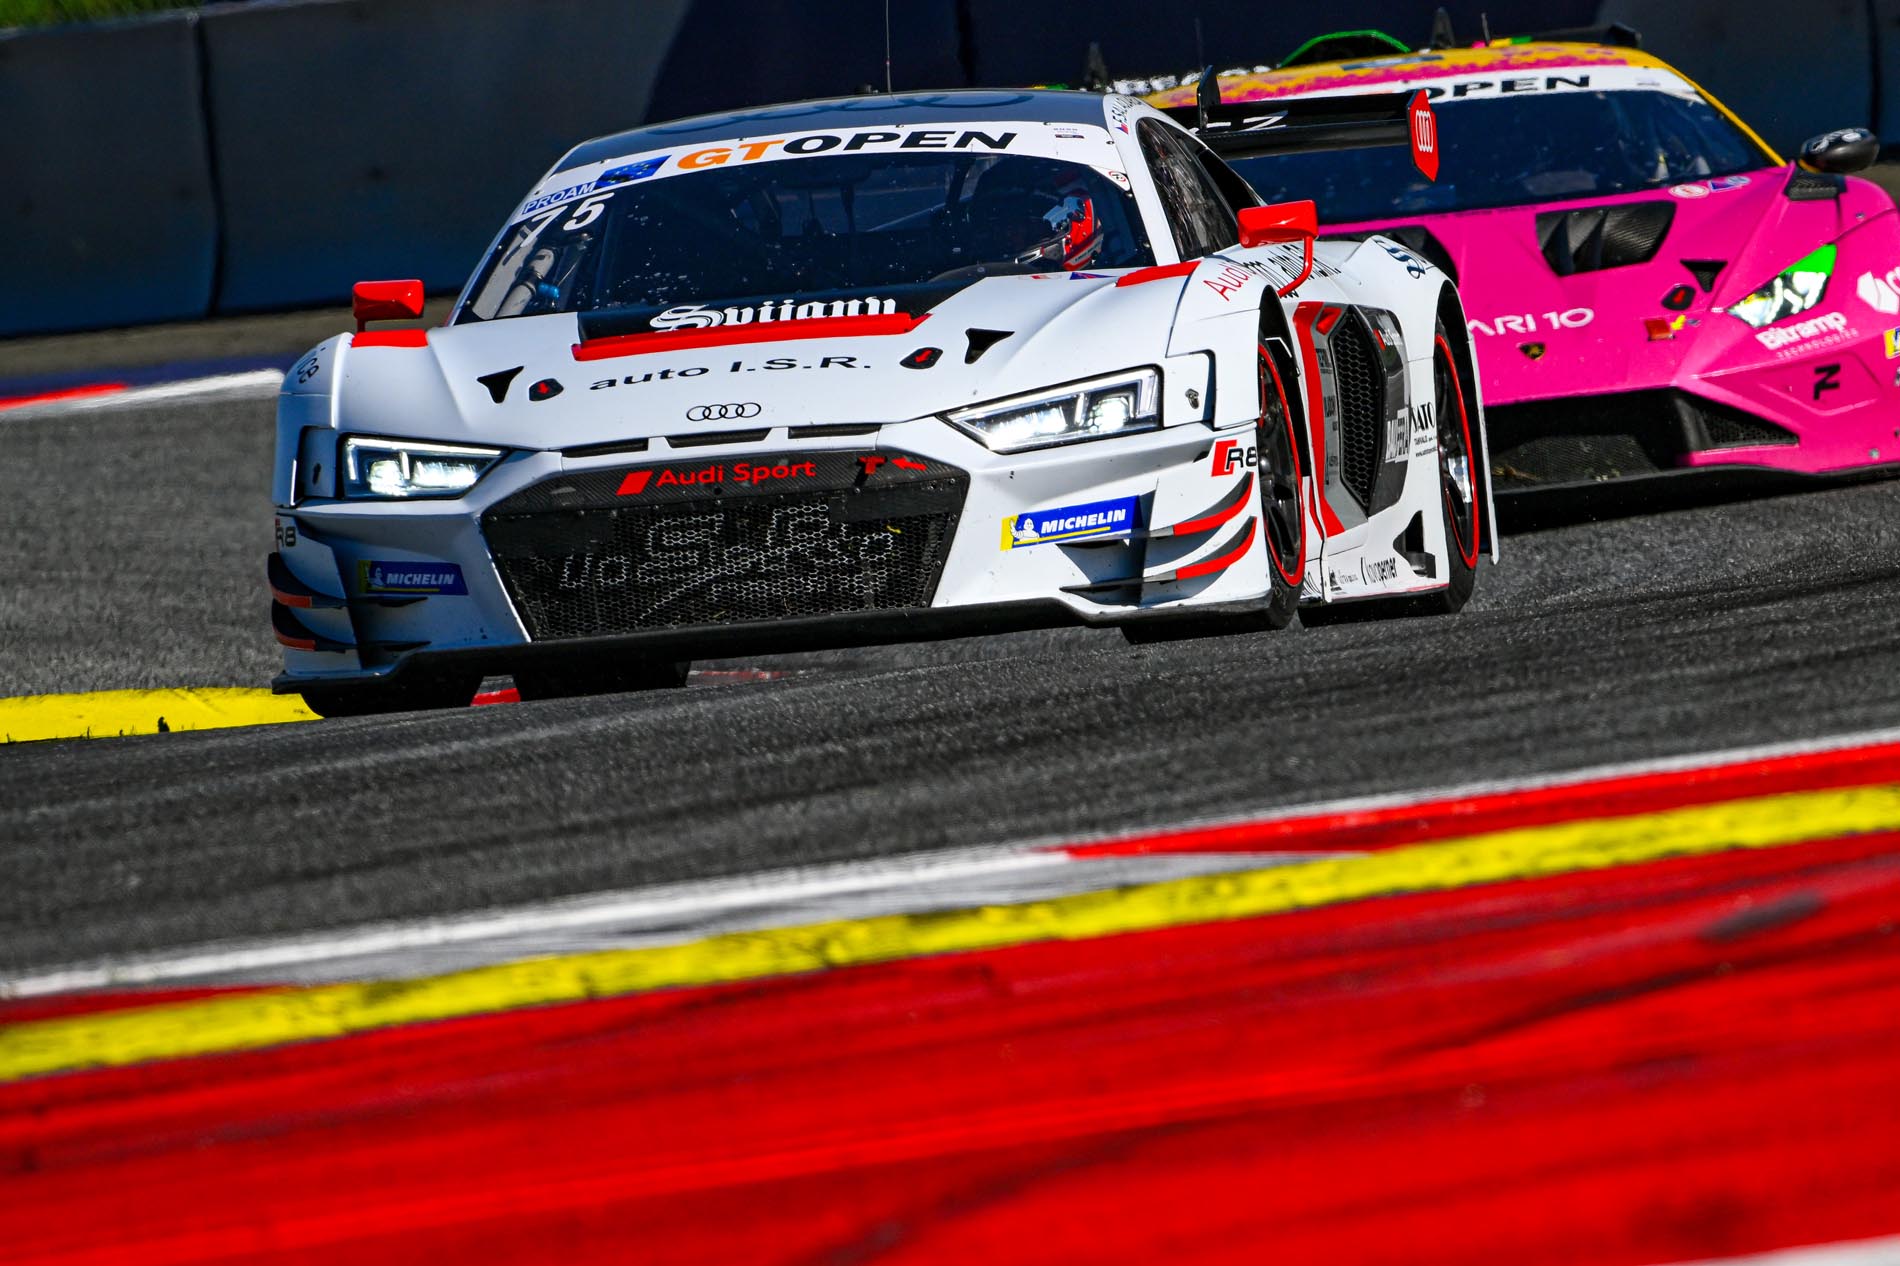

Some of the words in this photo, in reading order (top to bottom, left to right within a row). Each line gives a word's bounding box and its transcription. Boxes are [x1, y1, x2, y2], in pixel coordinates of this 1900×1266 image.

[522, 181, 597, 214] PROAM
[520, 191, 615, 248] 75
[1542, 307, 1595, 330] 10
[589, 367, 710, 391] auto
[729, 356, 872, 373] I.S.R.
[1225, 446, 1258, 470] R8
[656, 465, 724, 487] Audi
[733, 460, 817, 485] Sport
[1040, 508, 1127, 534] MICHELIN
[386, 572, 456, 586] MICHELIN
